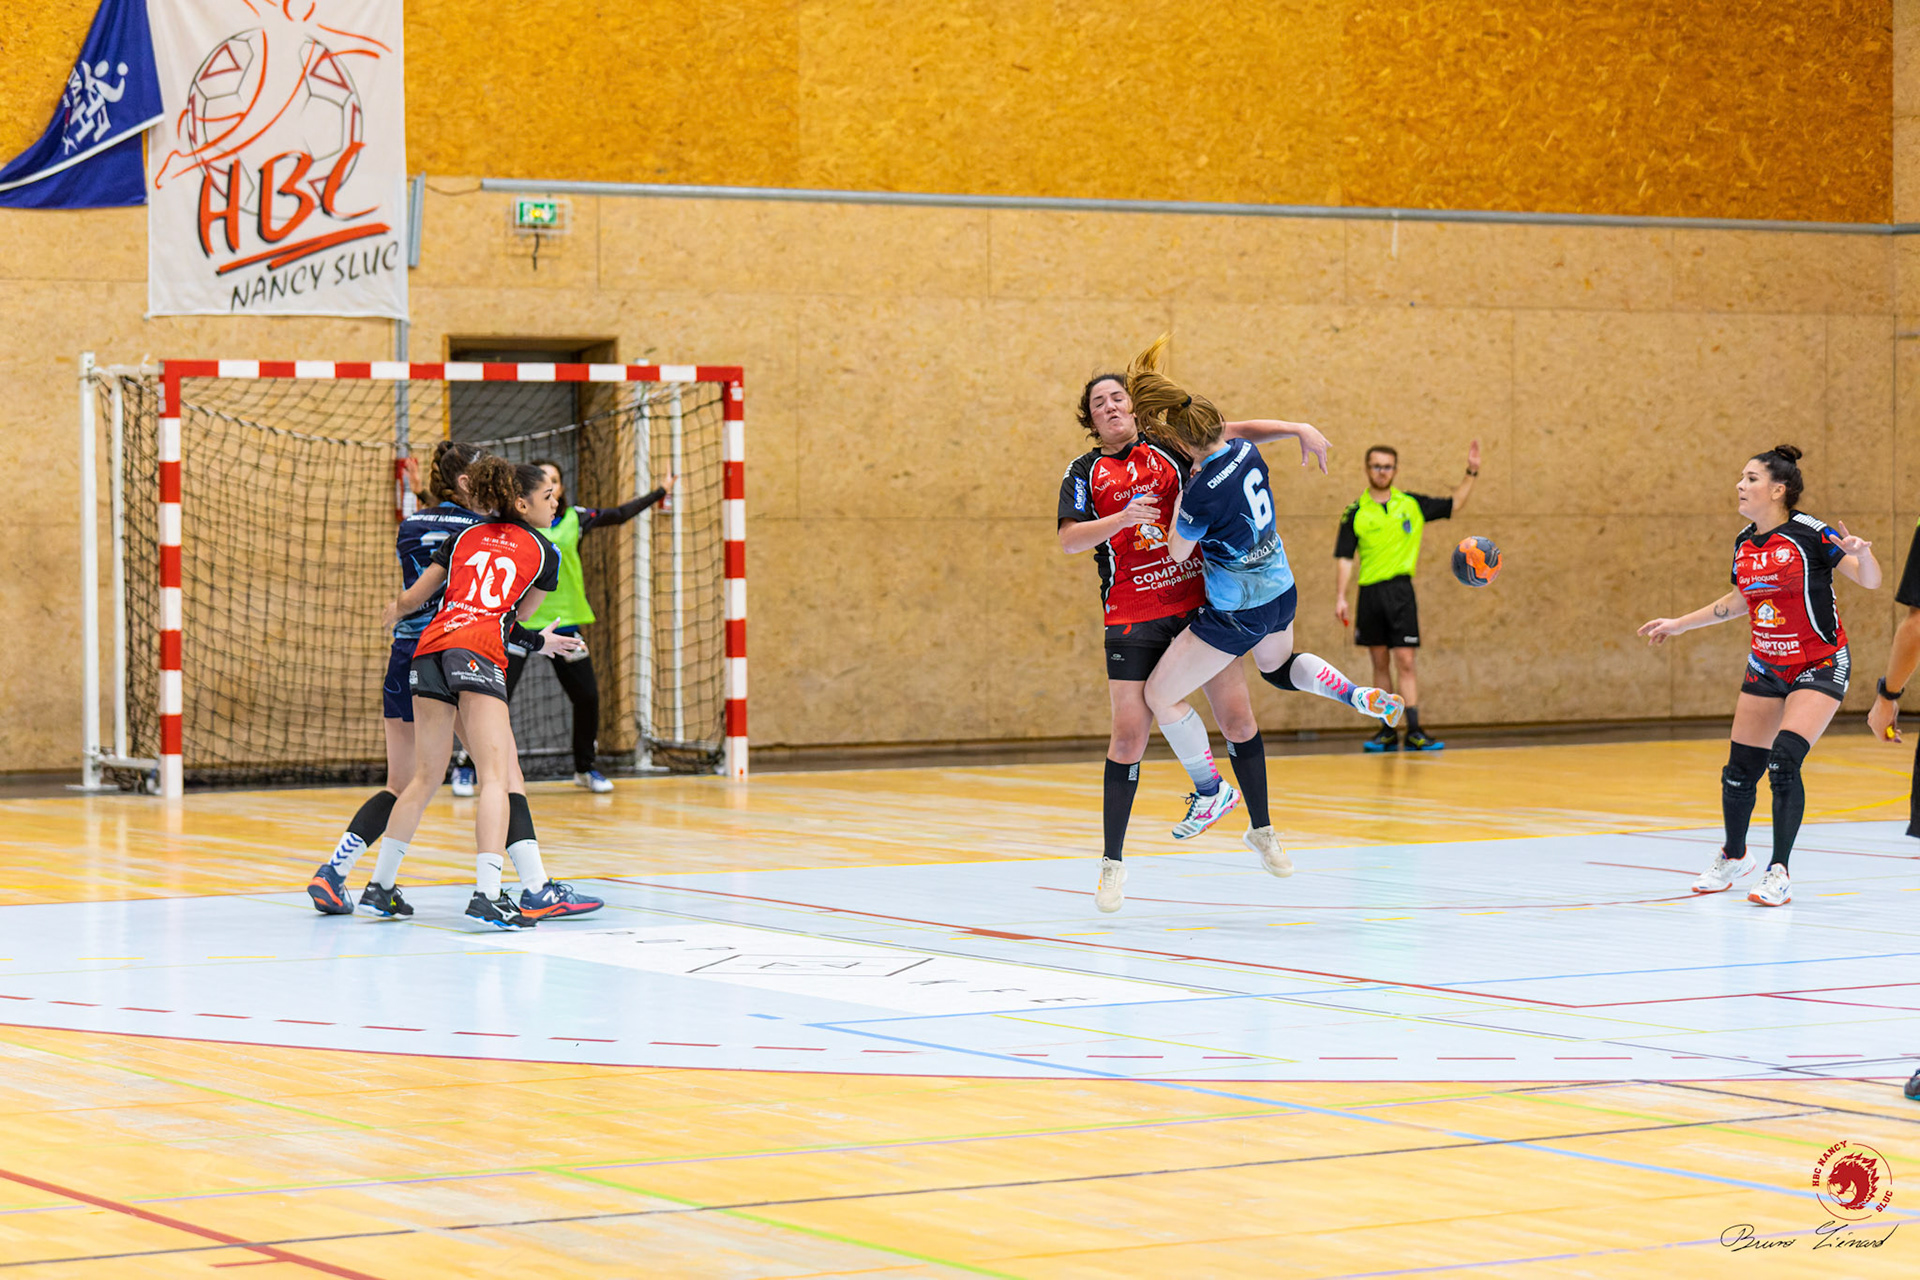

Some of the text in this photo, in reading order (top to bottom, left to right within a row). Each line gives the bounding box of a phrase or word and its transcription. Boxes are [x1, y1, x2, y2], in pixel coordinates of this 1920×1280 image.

[198, 141, 382, 258] HBC
[231, 241, 399, 311] NANCY SLUC
[1113, 489, 1131, 502] Guy
[1131, 479, 1160, 495] Hoquet
[1243, 467, 1272, 530] 6
[464, 550, 517, 609] 10
[1150, 569, 1198, 591] Campanile
[1161, 555, 1173, 565] LE
[1738, 573, 1779, 585] Guy Hoquet
